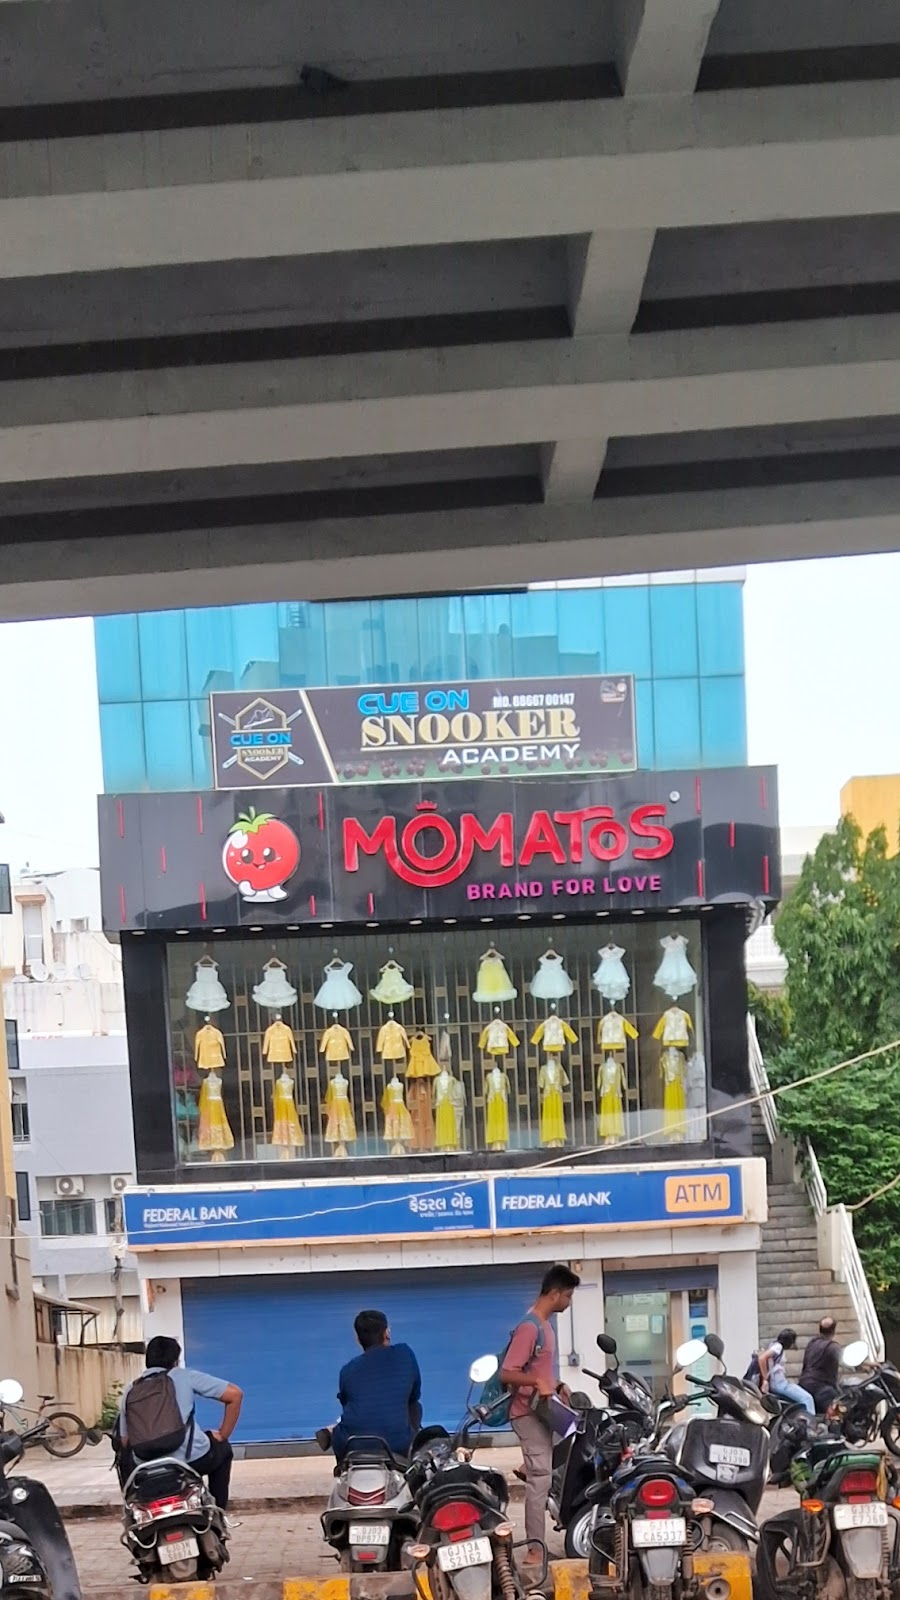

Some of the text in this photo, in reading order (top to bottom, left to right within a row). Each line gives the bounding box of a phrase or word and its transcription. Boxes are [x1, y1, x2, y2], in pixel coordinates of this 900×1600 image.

[358, 689, 470, 715] CUE ON
[513, 694, 544, 707] 88667
[545, 692, 575, 705] 00147
[361, 707, 581, 747] SNOOKER
[230, 731, 292, 746] CUE ON
[244, 755, 282, 763] ACADEMY
[442, 744, 581, 766] ACADEMY
[342, 802, 676, 888] MOMATOS
[466, 875, 663, 901] BRAND FOR LOVE
[502, 1191, 612, 1210] FEDERAL BANK
[674, 1182, 723, 1205] ATM
[143, 1205, 238, 1222] FEDERAL BANK
[650, 1519, 675, 1530] GJ11
[643, 1530, 683, 1542] CA5337
[447, 1541, 480, 1557] GJ13A
[449, 1551, 483, 1568] S2162
